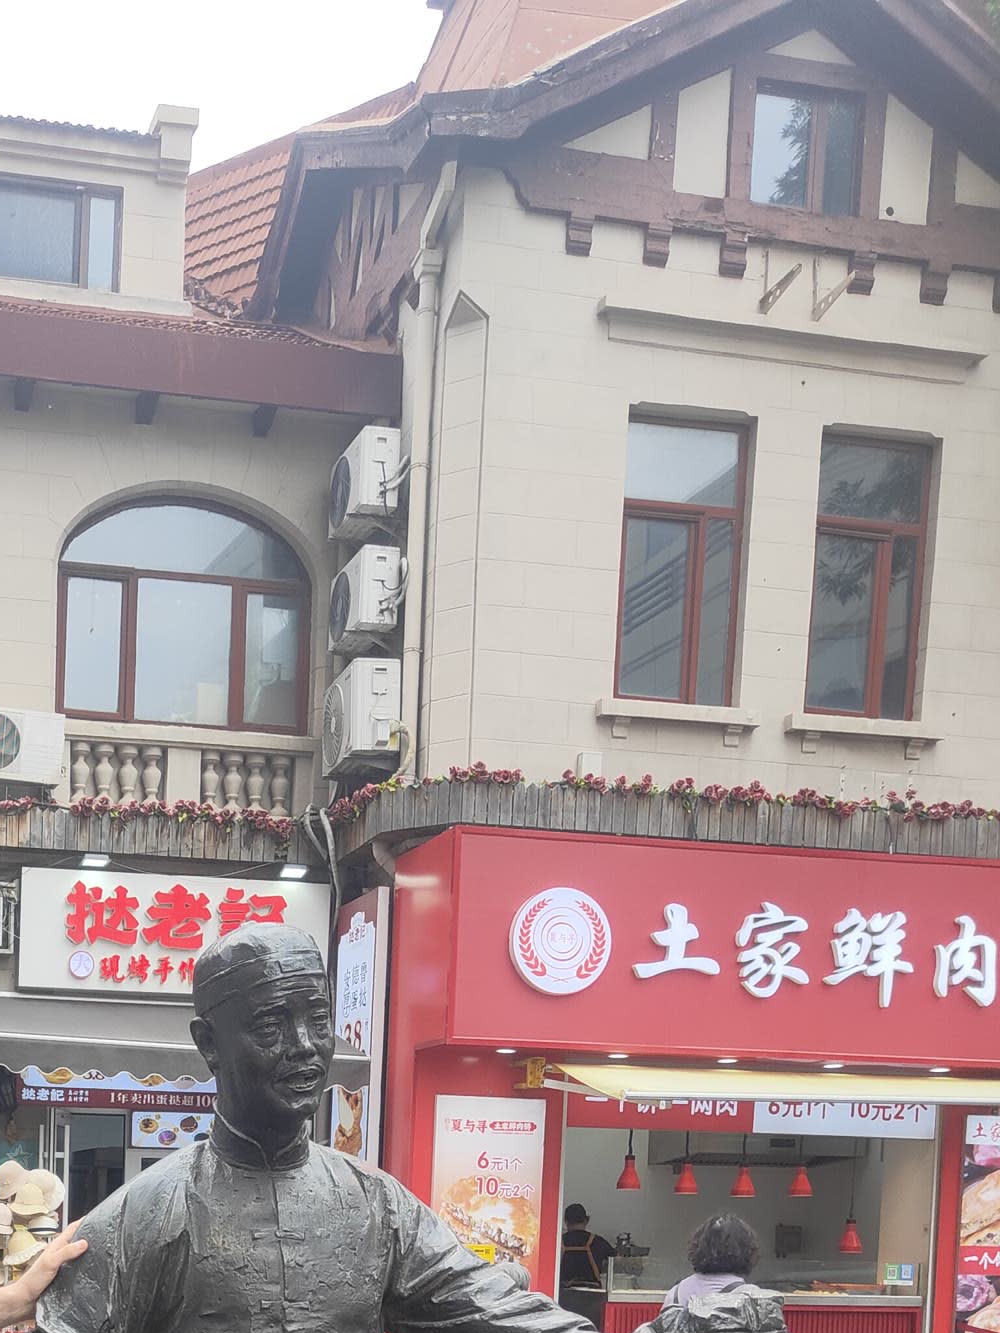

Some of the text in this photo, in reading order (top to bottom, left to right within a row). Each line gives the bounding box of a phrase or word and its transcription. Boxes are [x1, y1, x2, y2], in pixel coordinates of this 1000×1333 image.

[632, 901, 998, 1009] 土家鲜肉
[477, 1151, 523, 1173] 6元1个
[476, 1177, 535, 1200] 10元2个
